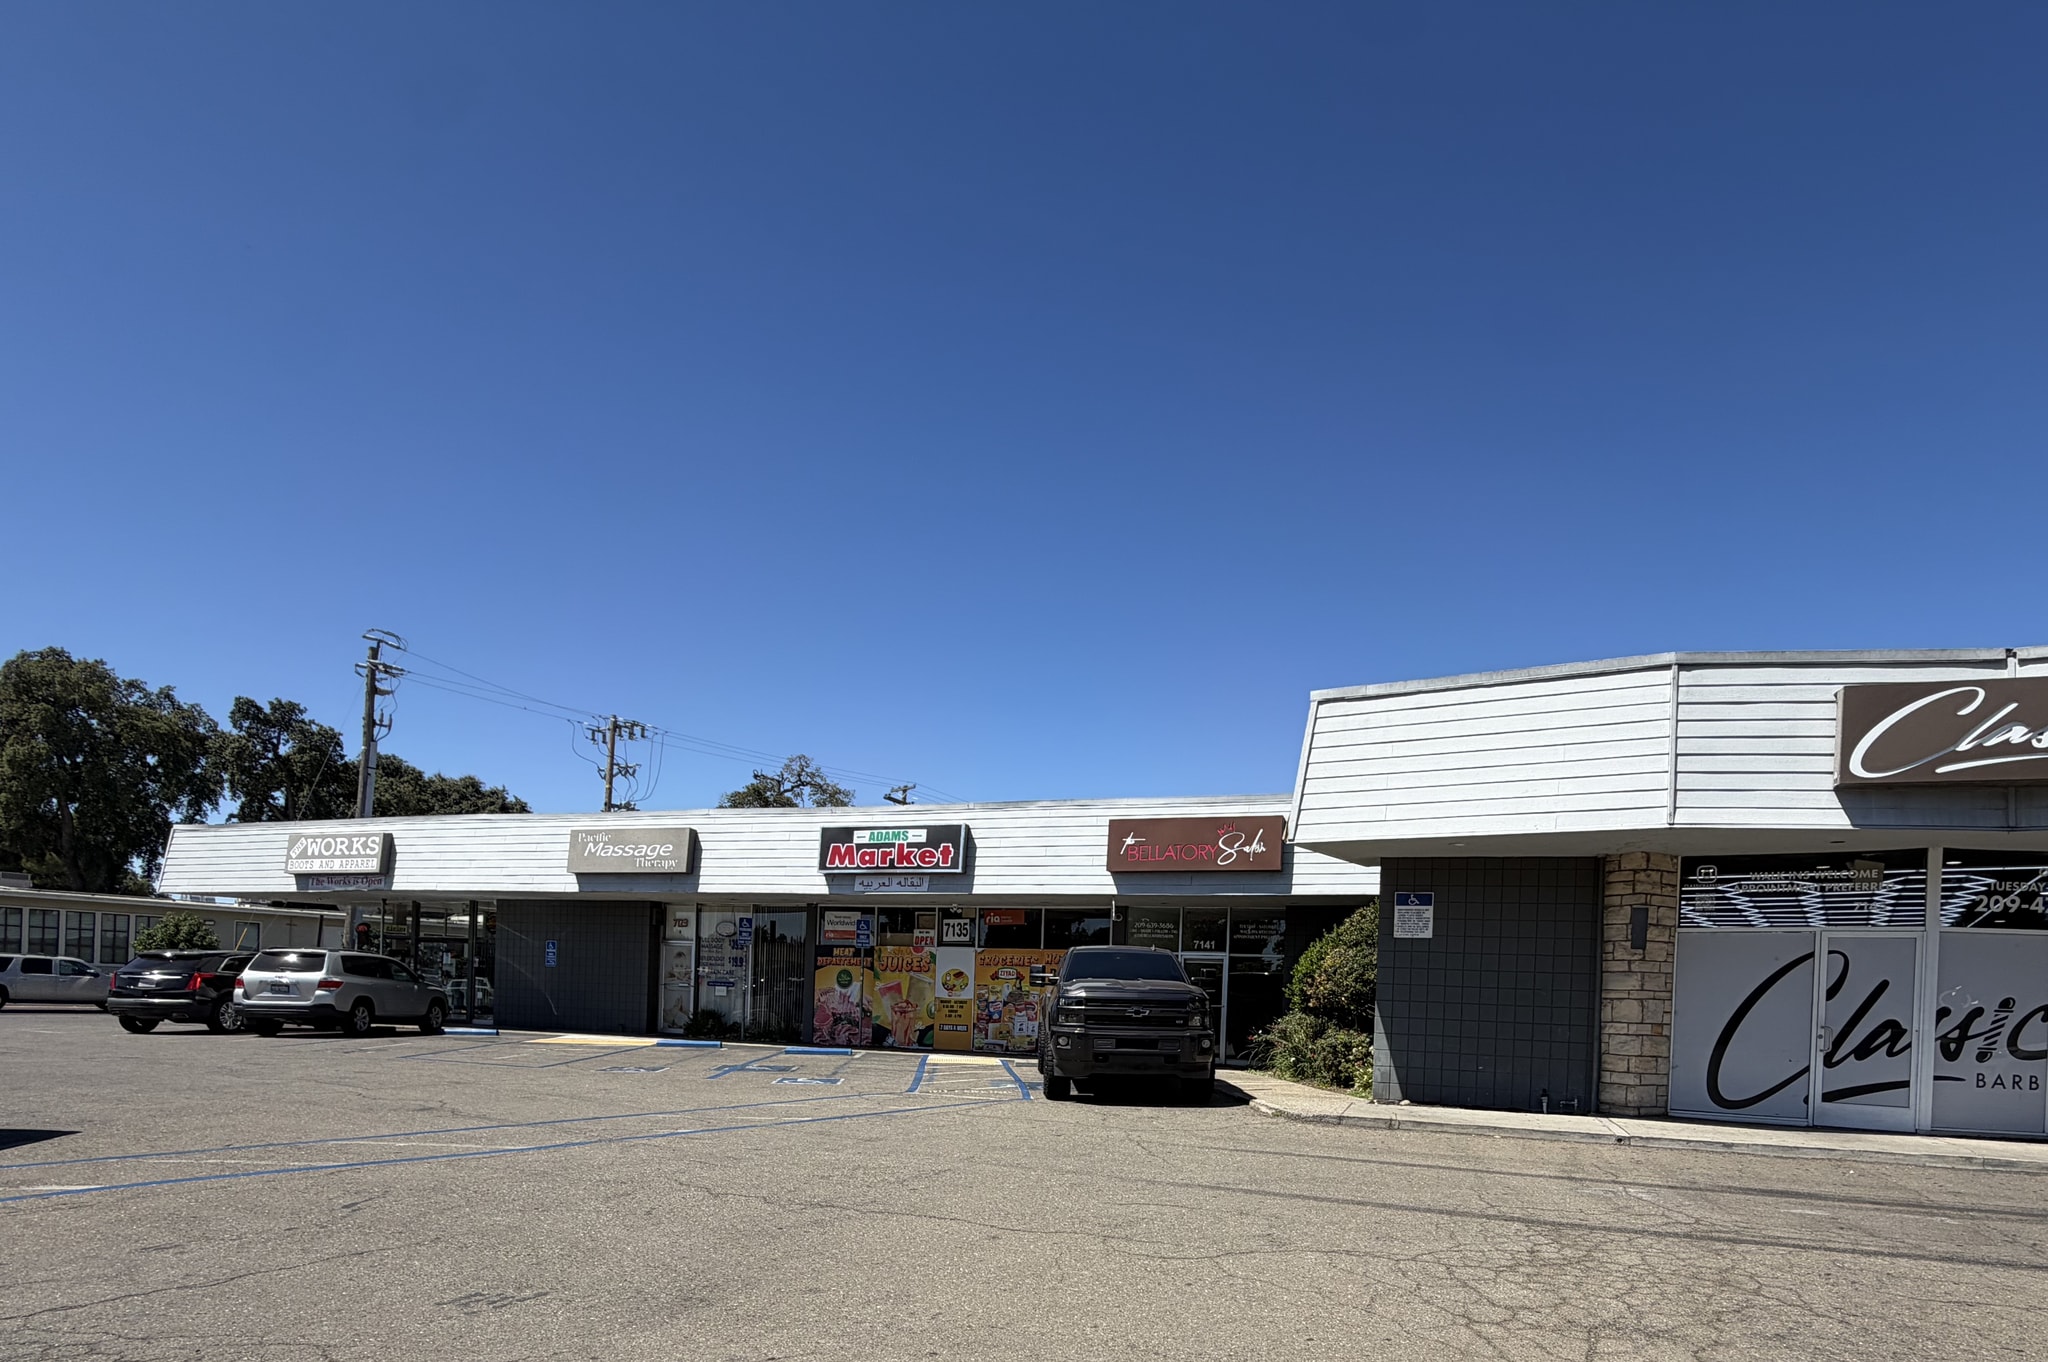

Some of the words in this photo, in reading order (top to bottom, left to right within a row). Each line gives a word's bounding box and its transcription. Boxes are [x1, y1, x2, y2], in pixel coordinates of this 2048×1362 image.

[579, 832, 612, 842] Pacific
[868, 831, 909, 841] ADAMS
[292, 839, 305, 857] THE
[307, 837, 380, 856] WORKS
[584, 843, 673, 859] Massage
[1127, 845, 1218, 861] BELLATORY
[1217, 829, 1266, 865] Salon
[826, 843, 954, 867] Market
[289, 861, 314, 869] BOOTS
[319, 861, 335, 869] AND
[339, 860, 376, 869] APPAREL
[634, 857, 678, 869] Therapy
[1750, 871, 1785, 880] WALK
[1814, 869, 1879, 879] WELCOME
[311, 878, 325, 886] The
[327, 877, 352, 886] Works
[362, 877, 383, 888] Open
[1733, 883, 1822, 893] APPOINTMENT
[1990, 881, 2045, 892] TUESDAY
[1974, 895, 2048, 913] 209-4
[827, 919, 857, 927] Worldwid
[986, 912, 1000, 923] ria
[944, 923, 969, 938] 7135
[915, 936, 935, 945] OPEN
[1194, 940, 1216, 949] 7141
[833, 948, 855, 957] MEAT
[880, 956, 931, 972] JUICES
[1976, 1073, 2040, 1090] BARB
